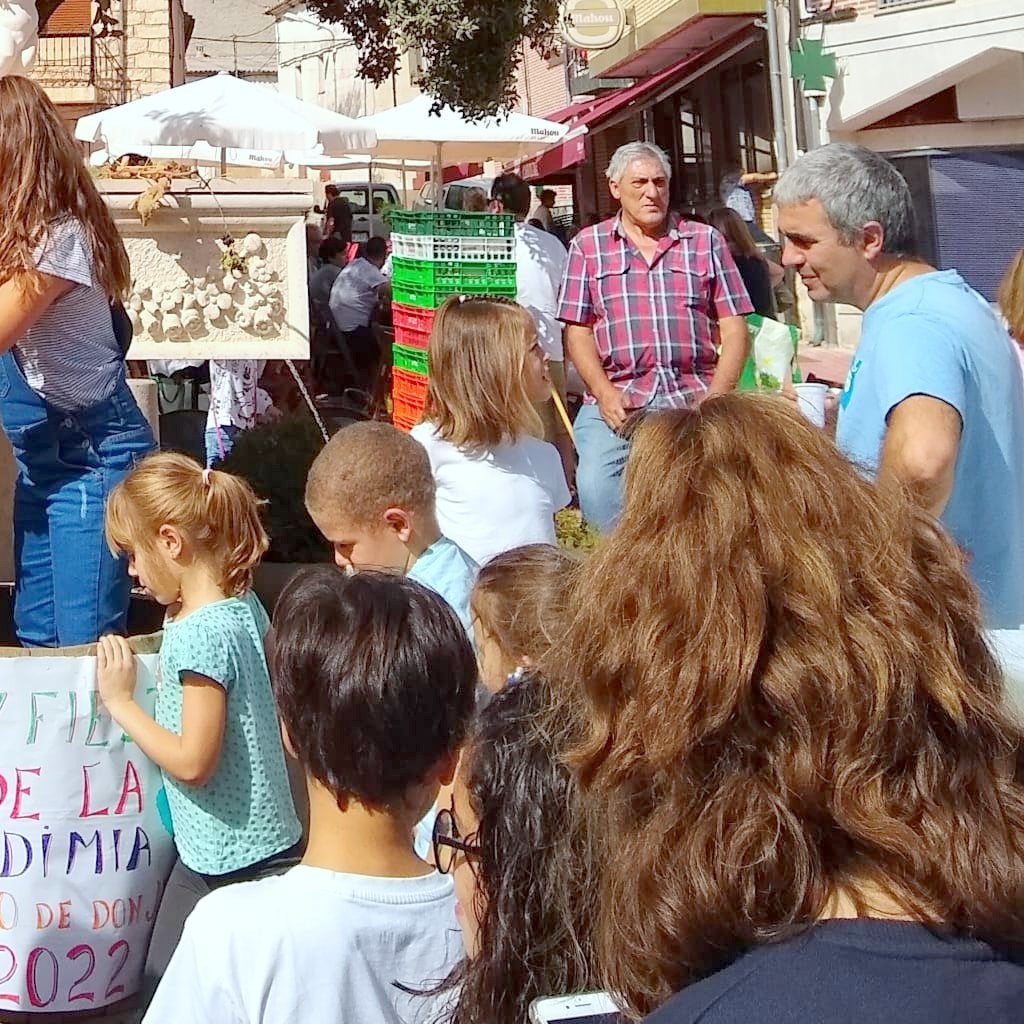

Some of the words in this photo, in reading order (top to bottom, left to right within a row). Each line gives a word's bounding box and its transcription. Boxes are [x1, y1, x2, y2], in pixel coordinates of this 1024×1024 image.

[78, 760, 144, 818] LA
[36, 898, 73, 930] DE
[92, 894, 144, 930] DON
